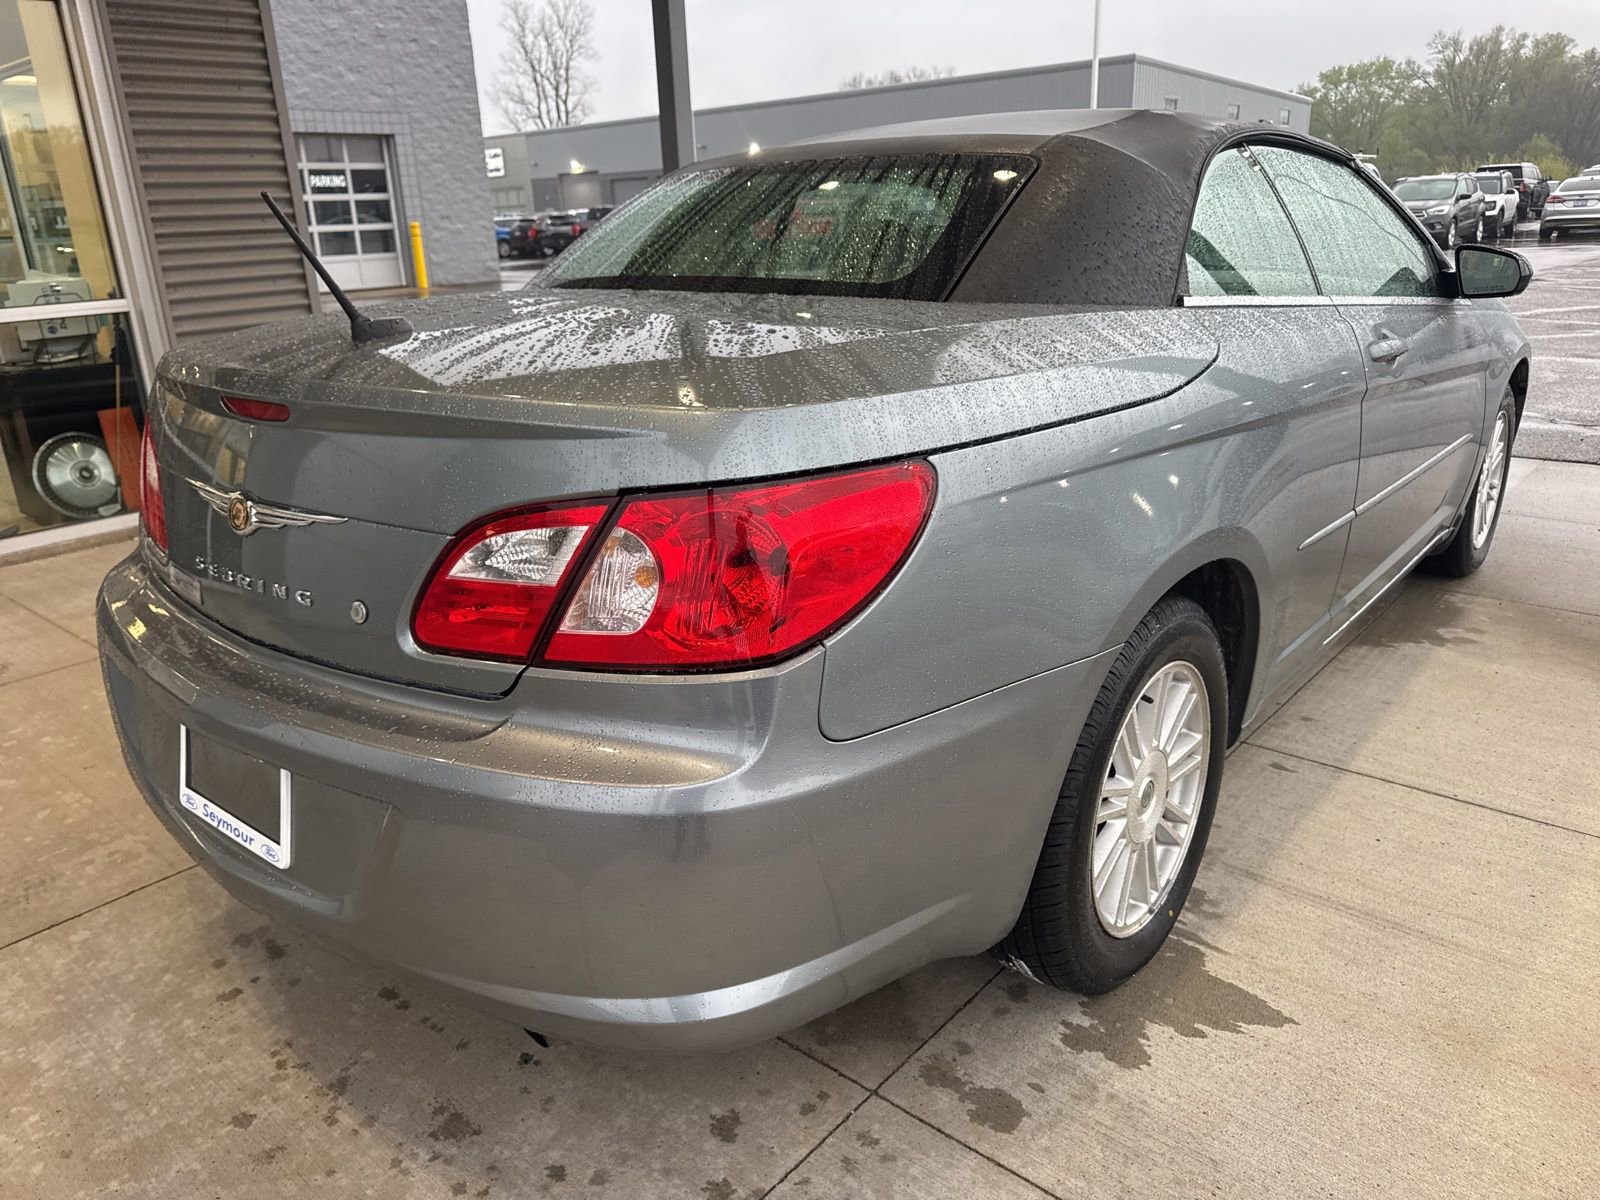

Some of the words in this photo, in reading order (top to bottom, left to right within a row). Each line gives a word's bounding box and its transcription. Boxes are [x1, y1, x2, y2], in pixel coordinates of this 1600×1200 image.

[310, 174, 346, 188] PARKING
[194, 555, 312, 607] SEBRING
[202, 803, 255, 846] Seymour
